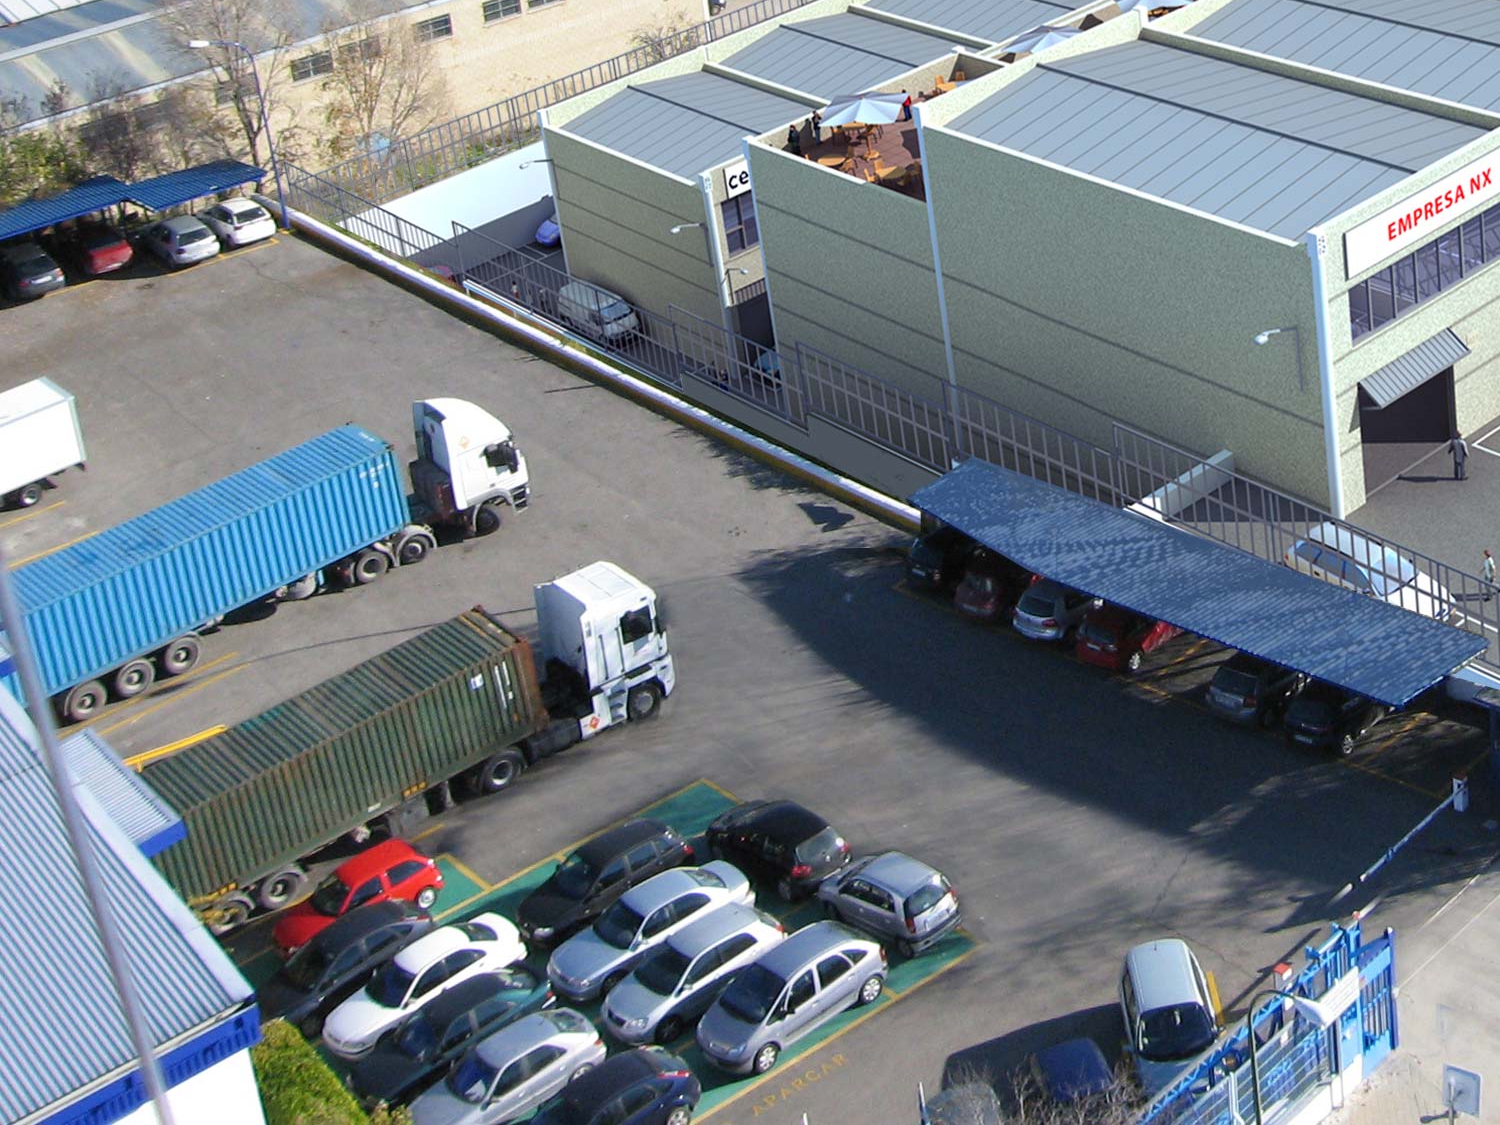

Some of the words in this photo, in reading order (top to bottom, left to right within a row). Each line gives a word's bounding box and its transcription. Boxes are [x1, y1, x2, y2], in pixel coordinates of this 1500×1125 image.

[1387, 184, 1465, 241] EMPRESA
[1469, 167, 1492, 194] NX
[752, 1053, 846, 1116] APARCAR
